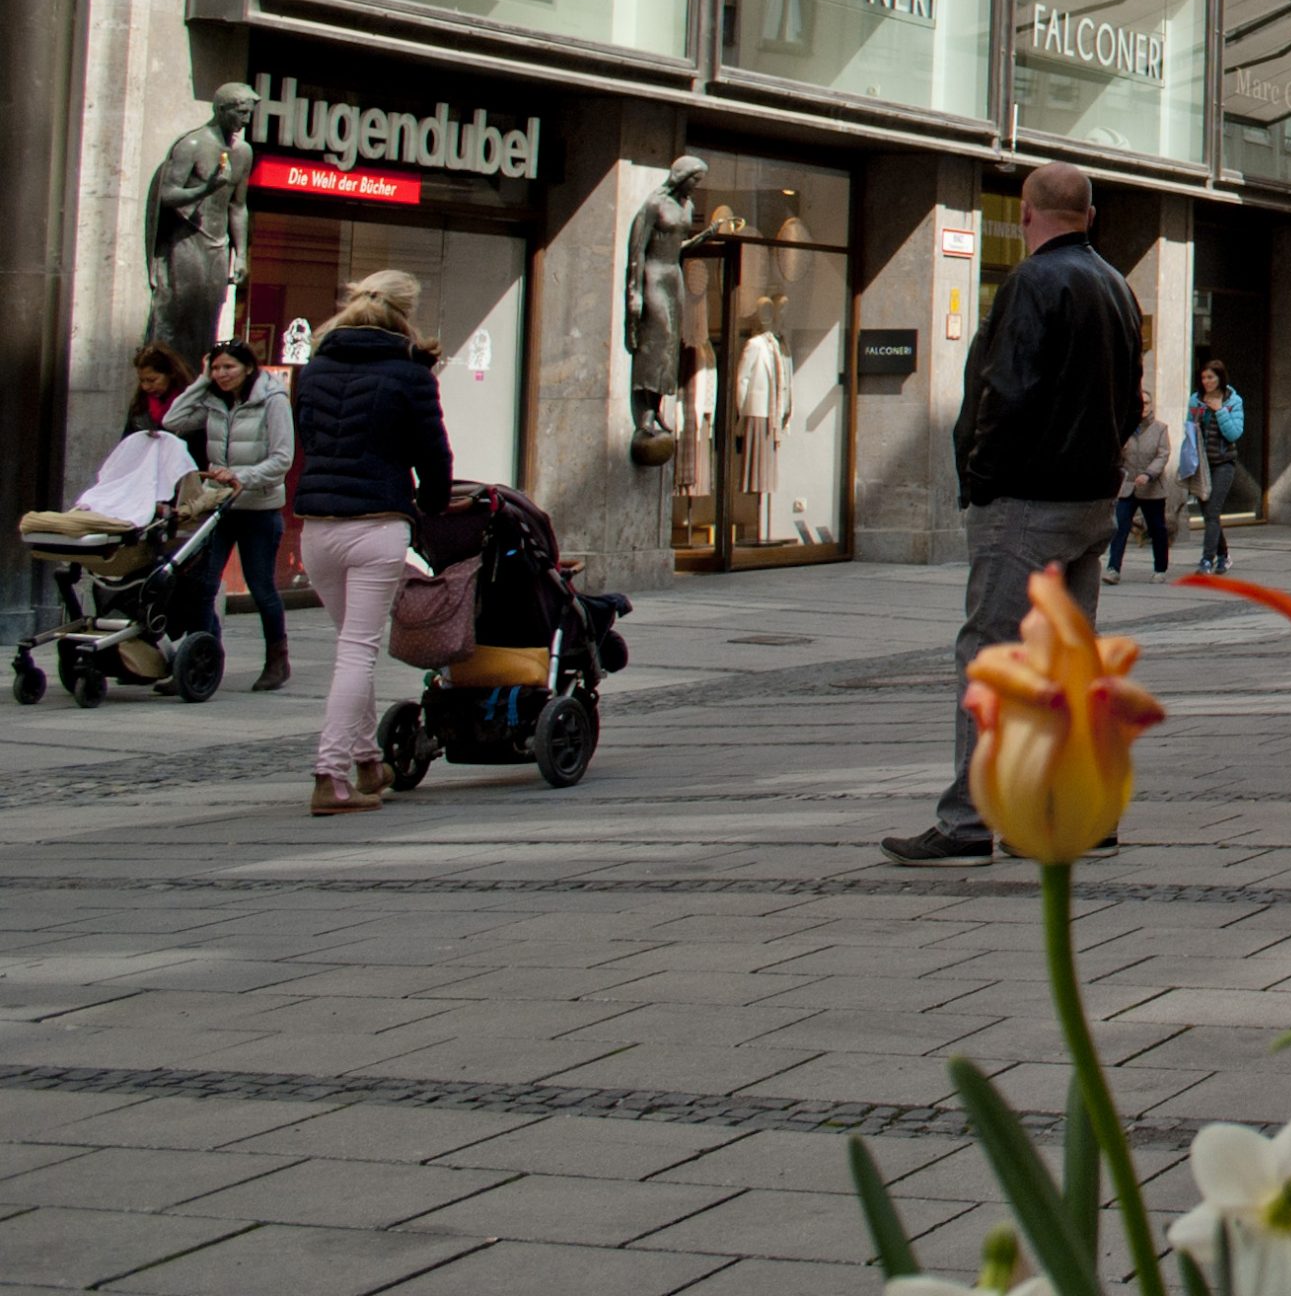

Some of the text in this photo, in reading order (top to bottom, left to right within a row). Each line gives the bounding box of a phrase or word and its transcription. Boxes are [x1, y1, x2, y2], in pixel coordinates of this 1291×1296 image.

[1235, 66, 1280, 105] Marc
[252, 72, 540, 180] Hugendubel
[288, 168, 397, 197] Die Welt der Bücher
